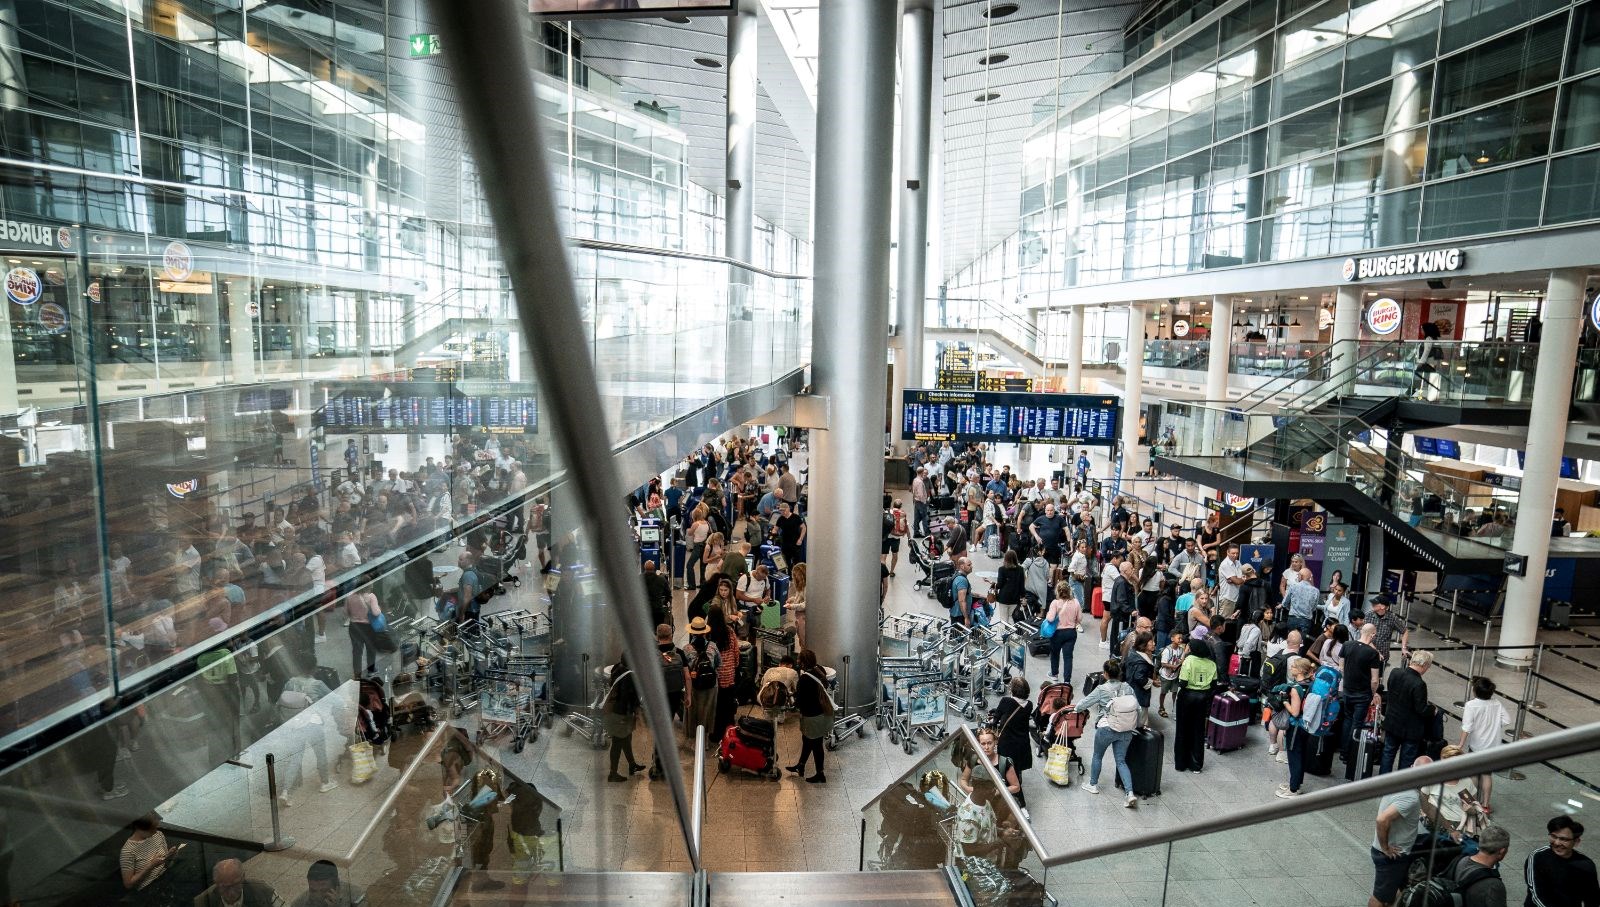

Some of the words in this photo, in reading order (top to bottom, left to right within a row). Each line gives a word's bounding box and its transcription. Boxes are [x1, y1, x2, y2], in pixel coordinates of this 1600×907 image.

[1359, 253, 1414, 278] BURGER
[1417, 248, 1459, 272] KING
[1372, 306, 1397, 318] BURGER
[1372, 311, 1398, 326] KING
[950, 433, 956, 441] 3
